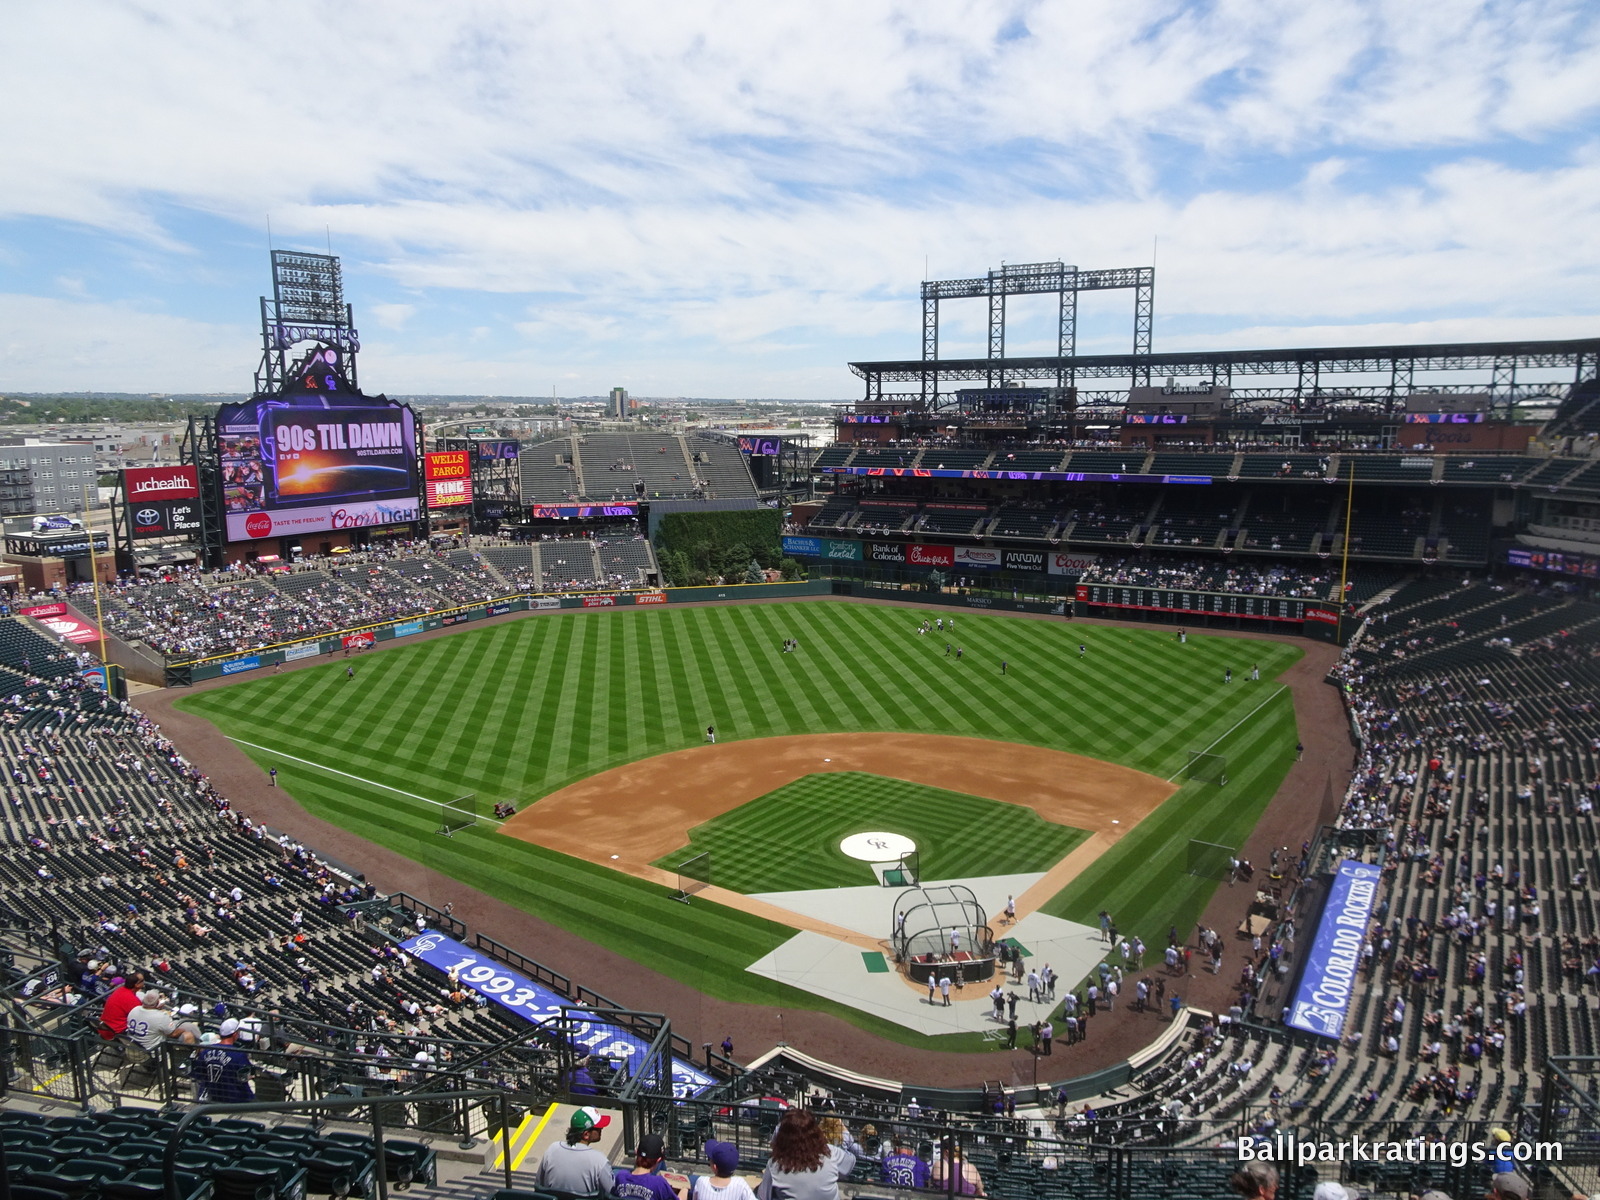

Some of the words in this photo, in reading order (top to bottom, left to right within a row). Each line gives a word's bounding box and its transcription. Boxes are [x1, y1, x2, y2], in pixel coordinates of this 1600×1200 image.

[267, 325, 361, 353] ROCKIES
[276, 424, 316, 451] 90s
[316, 424, 347, 450] TIL
[348, 422, 402, 448] DAWN
[431, 454, 464, 464] WELLS
[432, 466, 464, 476] FARGO
[136, 475, 190, 491] uchealth
[435, 480, 465, 495] KING
[173, 506, 191, 515] Let's
[173, 514, 185, 522] Go
[301, 516, 324, 524] FEELING
[331, 508, 380, 529] Coors
[382, 509, 419, 524] LIGHT
[135, 525, 164, 533] TOYOTA
[174, 521, 201, 529] Places
[48, 540, 107, 553] TUNDRA
[872, 544, 888, 552] Bank
[889, 545, 899, 553] of
[828, 548, 856, 560] dental
[872, 553, 905, 562] Colorado
[1006, 553, 1043, 564] ARROW
[1055, 553, 1092, 568] Coors
[638, 595, 663, 603] STIHL
[228, 660, 245, 668] BURNS
[1336, 879, 1375, 930] ROCKIES
[1312, 928, 1362, 1009] COLORADO
[45, 973, 58, 985] 334
[206, 1063, 223, 1083] 17
